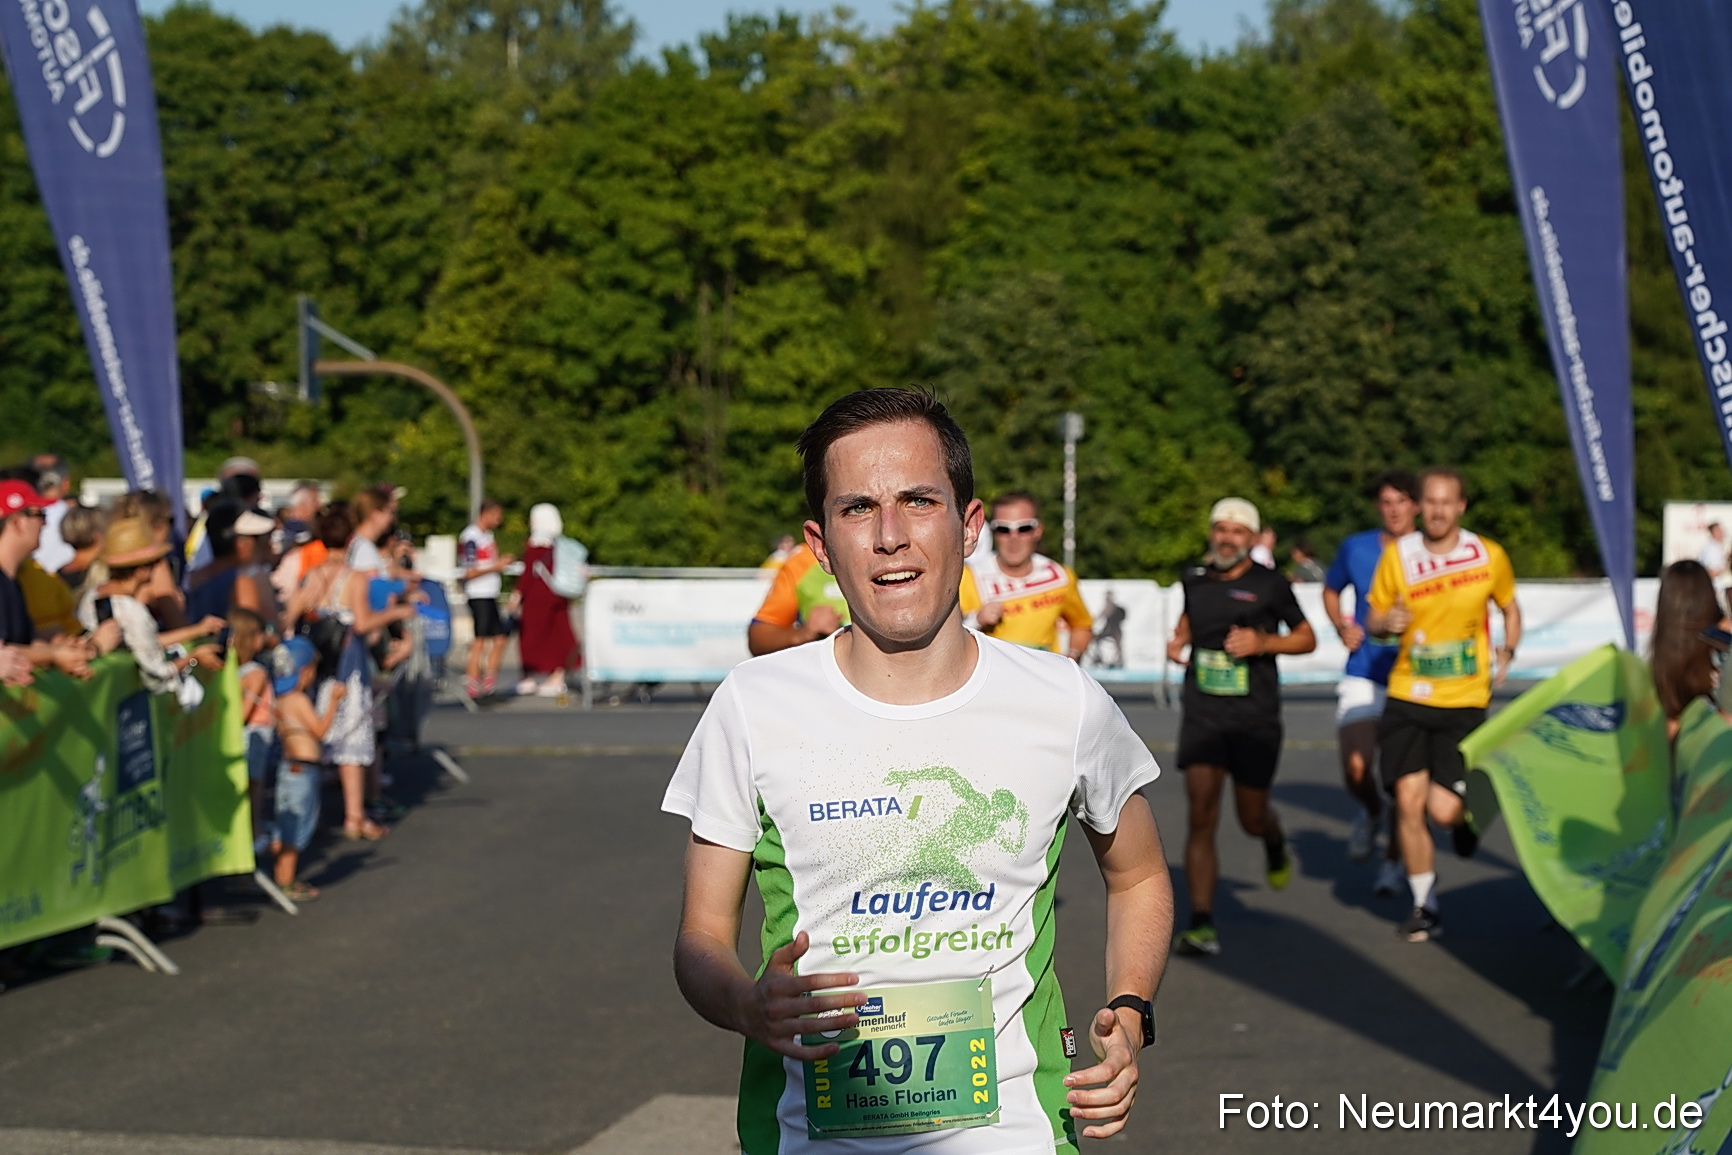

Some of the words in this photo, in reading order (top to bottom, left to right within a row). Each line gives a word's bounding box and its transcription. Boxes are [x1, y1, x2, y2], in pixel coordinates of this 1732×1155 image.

[808, 796, 902, 822] BERATA
[850, 882, 996, 920] Laufend
[832, 922, 1014, 960] erfolgreich
[854, 1012, 907, 1029] rmenlauf
[870, 1021, 907, 1033] neumarkt
[848, 1034, 946, 1086] 497
[969, 1037, 989, 1105] 2022
[814, 1059, 832, 1109] RUN
[846, 1093, 890, 1109] Haas
[894, 1087, 957, 1105] Florian
[862, 1113, 889, 1121] BERATA
[890, 1112, 910, 1120] GmbH
